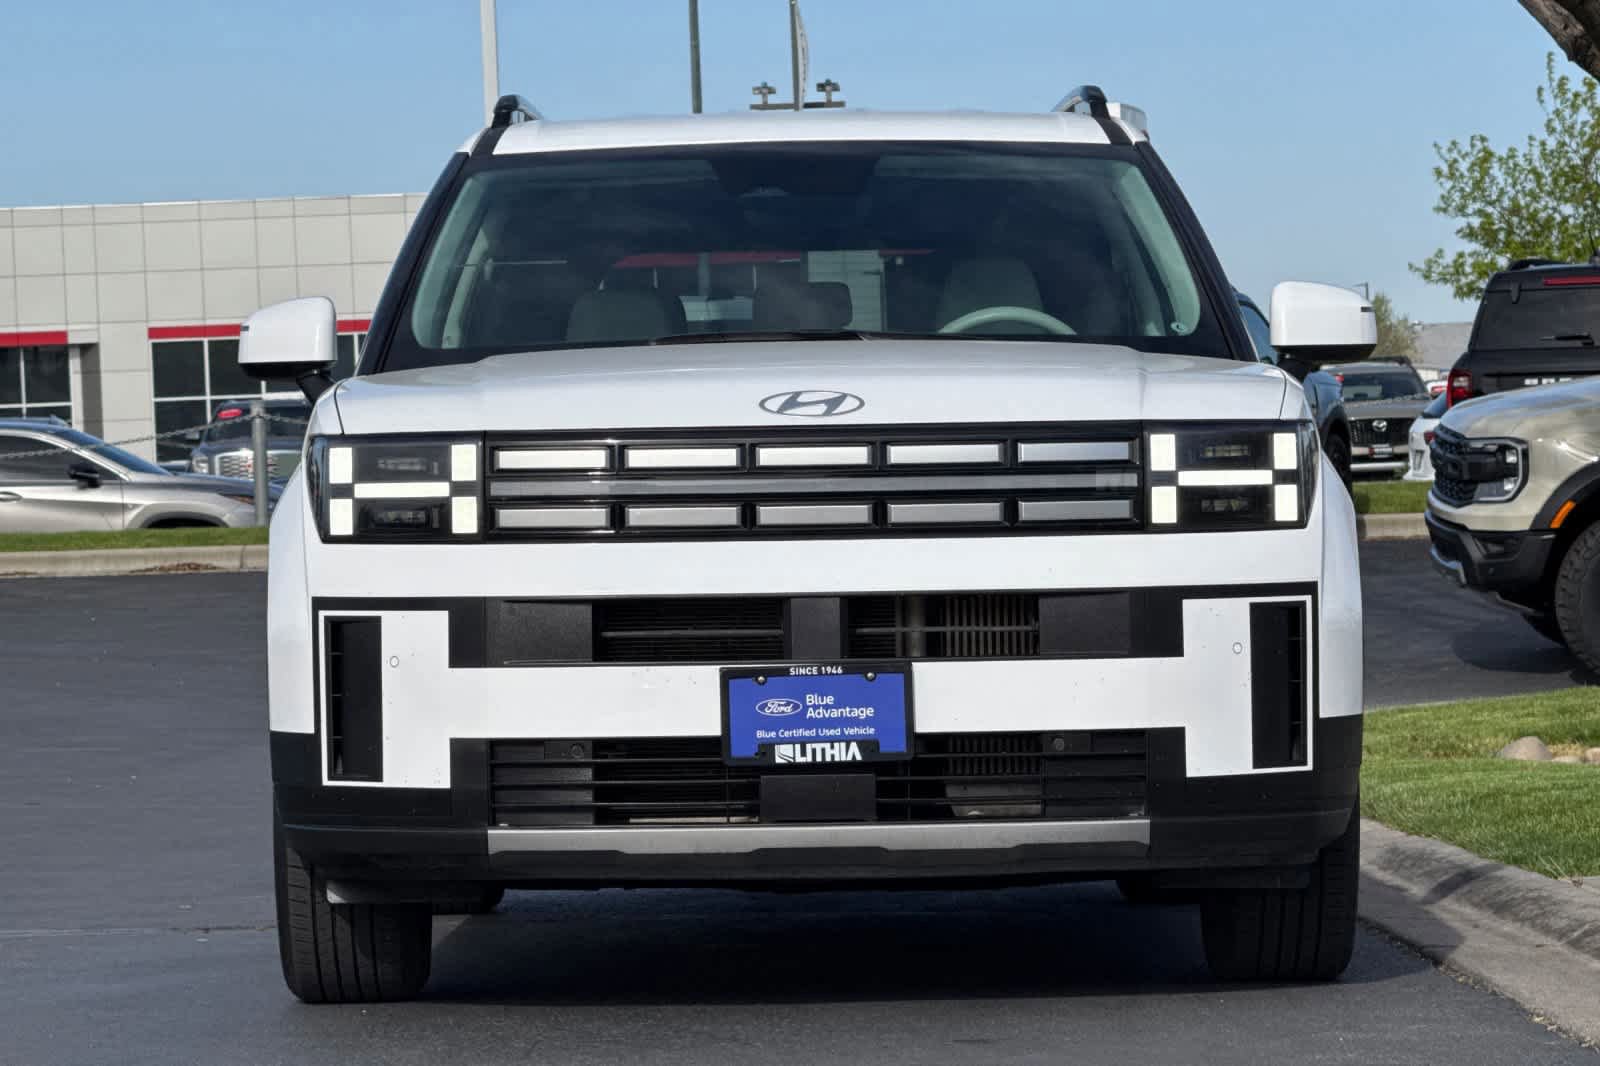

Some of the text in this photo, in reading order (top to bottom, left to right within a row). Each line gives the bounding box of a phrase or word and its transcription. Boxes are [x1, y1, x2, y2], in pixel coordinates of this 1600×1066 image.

[789, 666, 843, 676] SINCE 1946
[805, 694, 834, 706] Blue
[764, 701, 793, 714] Ford
[806, 706, 875, 720] Advantage
[756, 726, 875, 738] Blue Certified Used Vehicle
[795, 741, 863, 763] LITHIA
